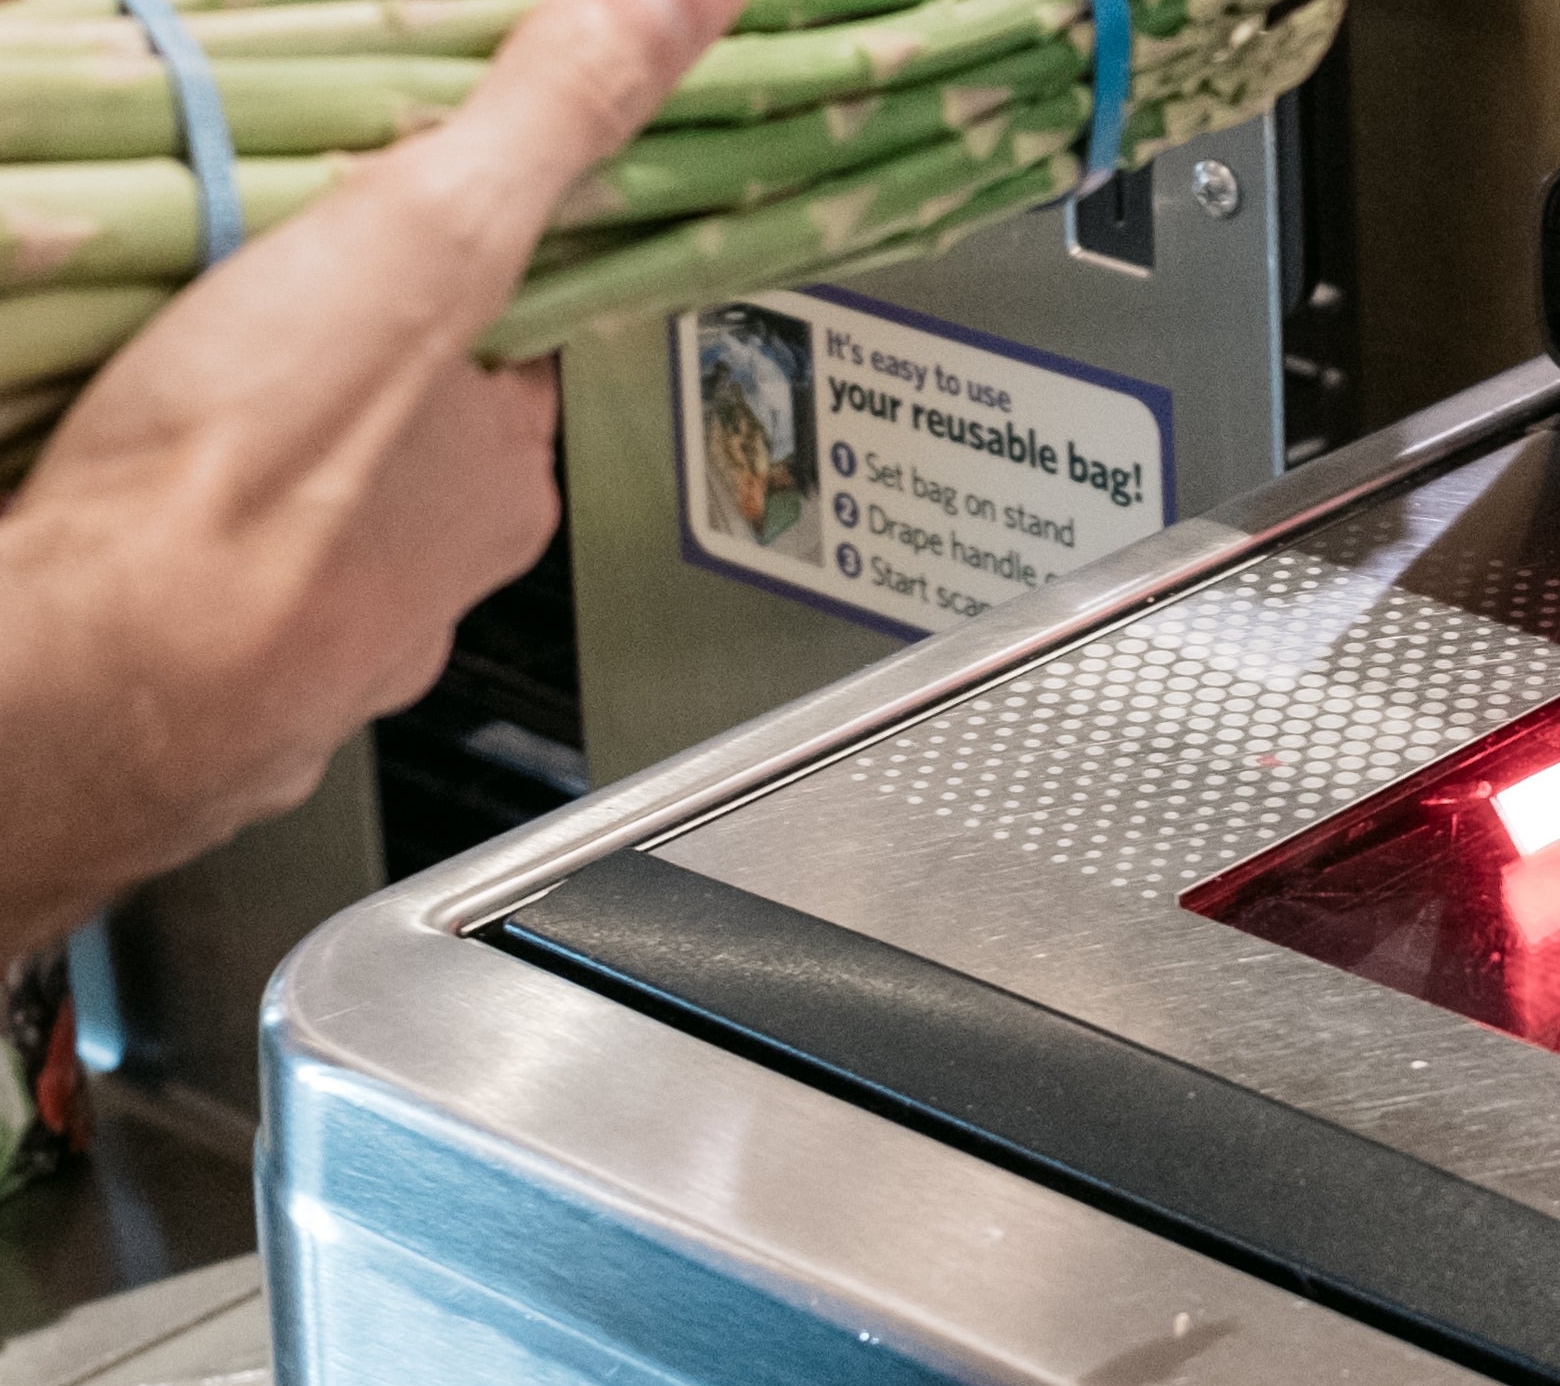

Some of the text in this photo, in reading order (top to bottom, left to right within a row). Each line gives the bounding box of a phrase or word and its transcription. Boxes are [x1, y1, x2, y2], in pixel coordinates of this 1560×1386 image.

[826, 328, 1013, 413] It's easy to use
[828, 375, 1144, 508] your reusable bag!
[865, 451, 904, 493] Set
[911, 466, 959, 516] bag
[965, 494, 997, 523] on
[1003, 503, 1076, 549] stand
[867, 504, 944, 556] Drape
[951, 529, 1038, 587] handle
[870, 555, 930, 603] Start
